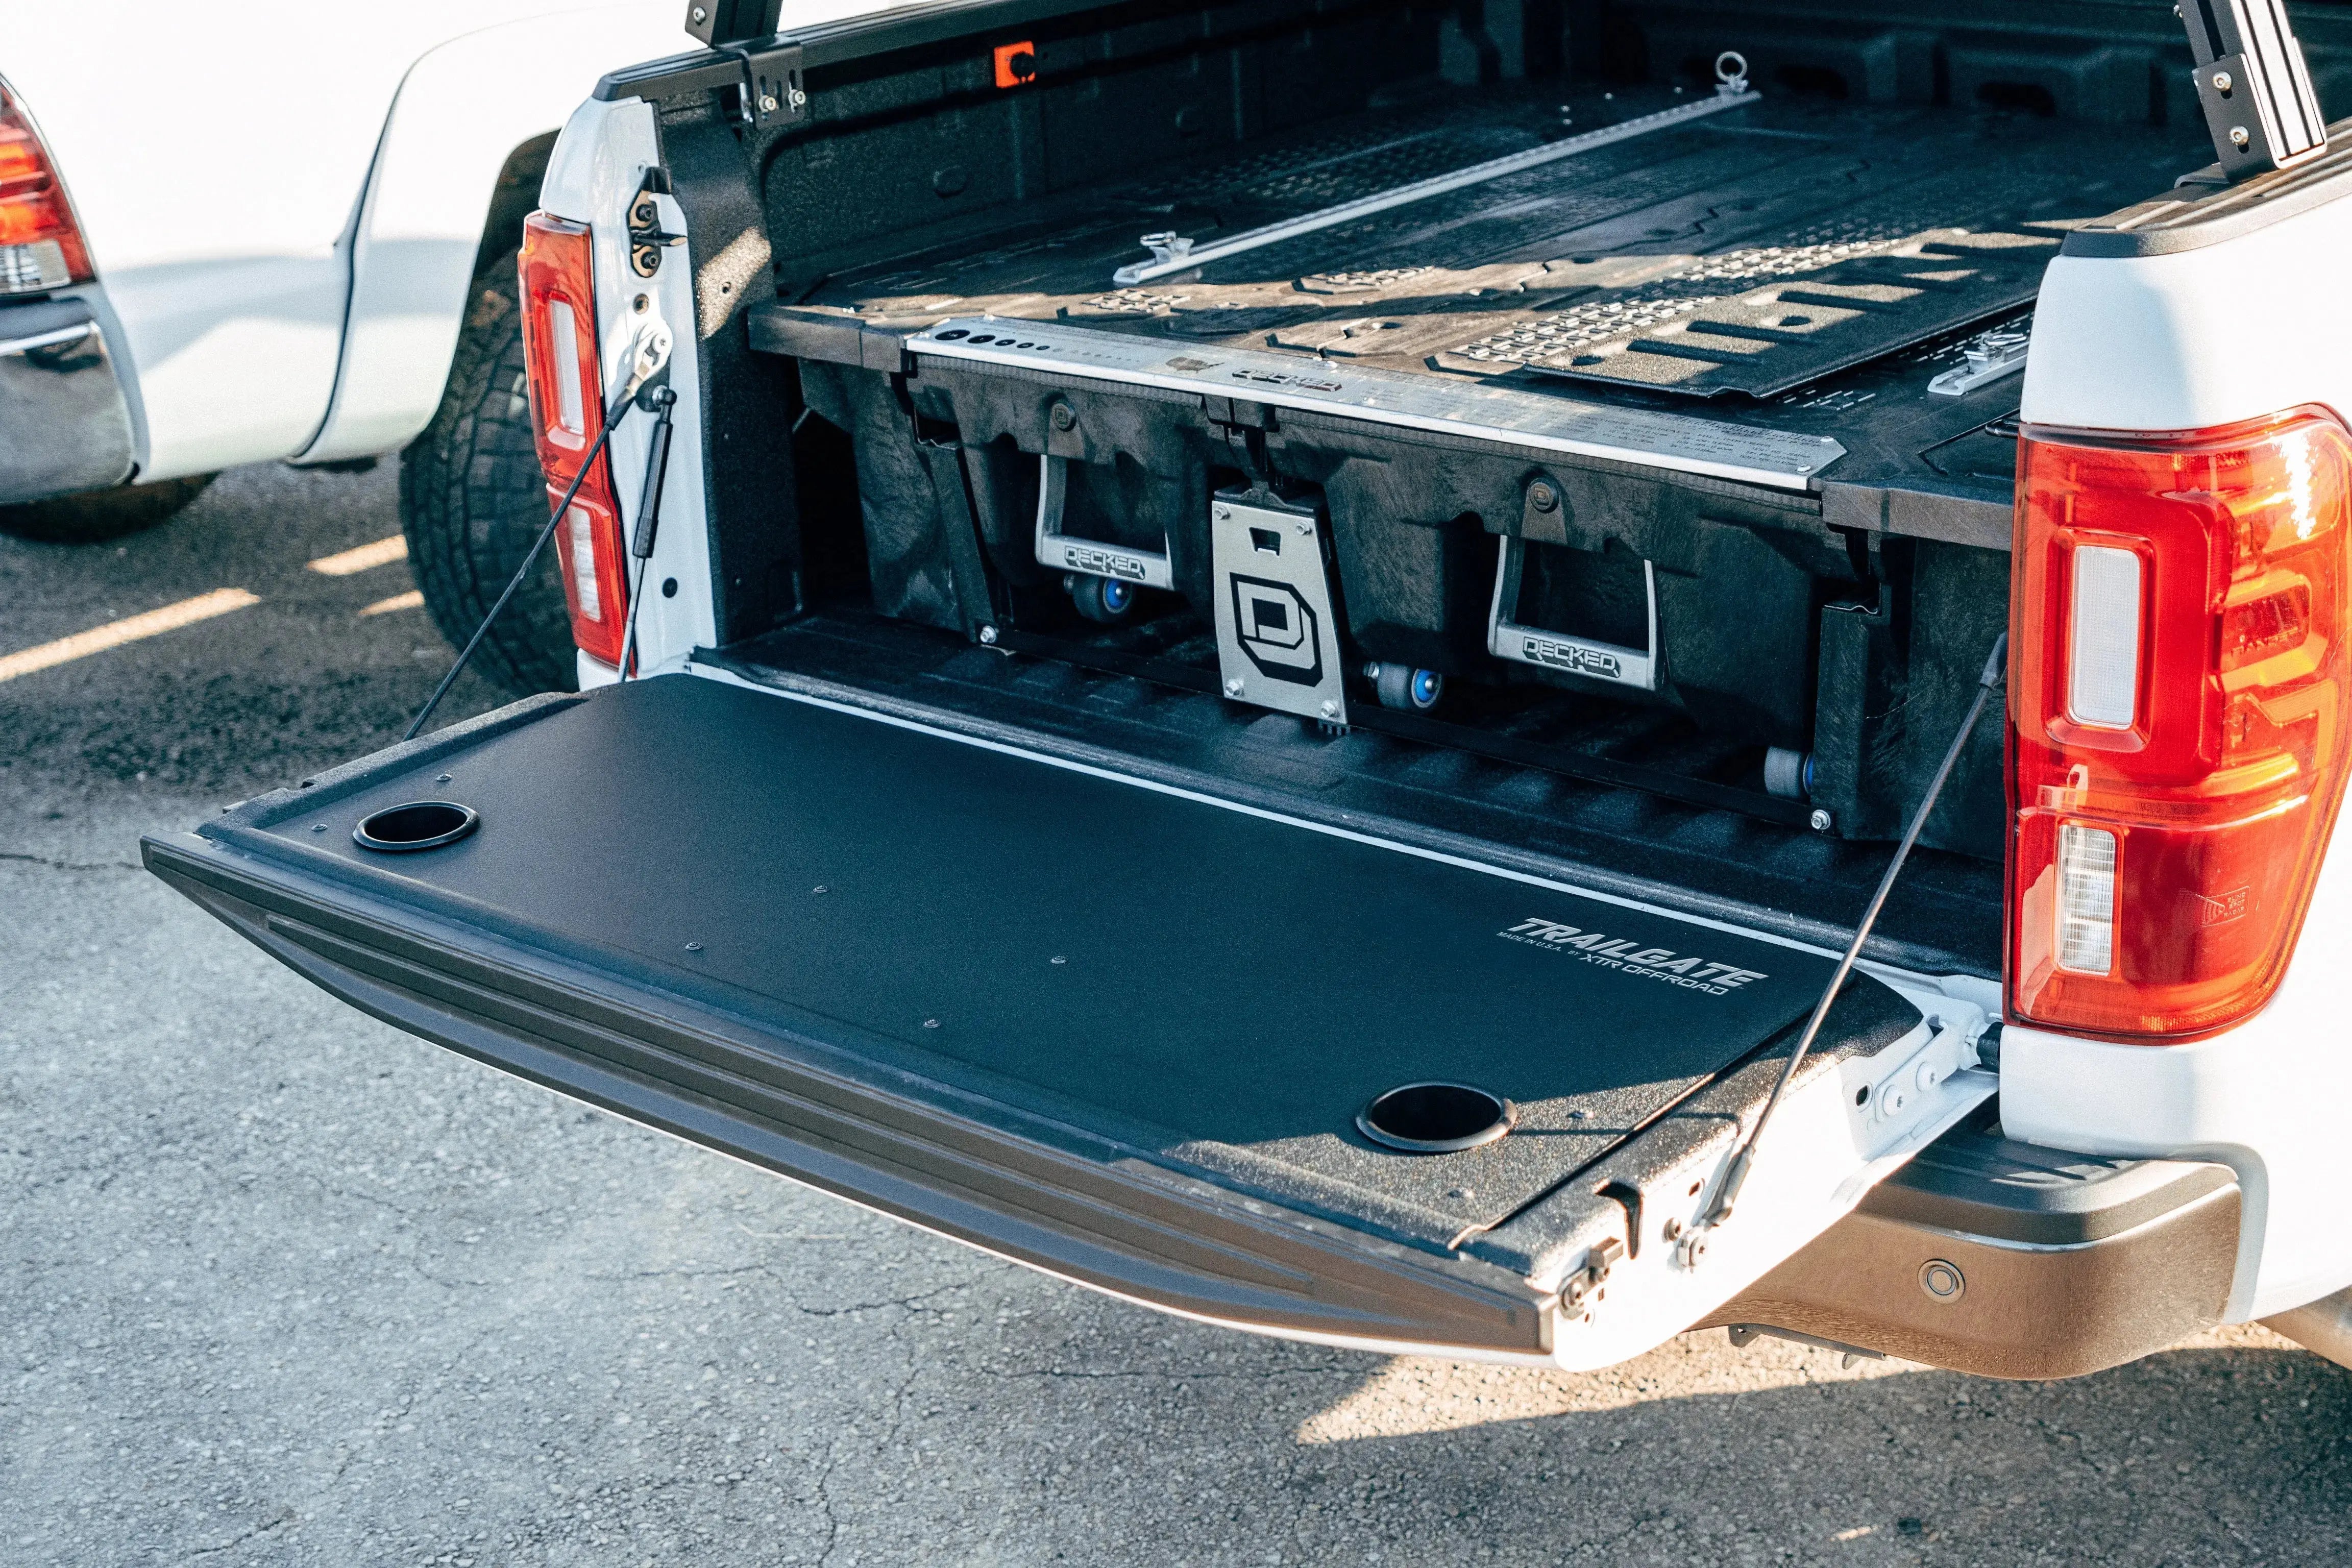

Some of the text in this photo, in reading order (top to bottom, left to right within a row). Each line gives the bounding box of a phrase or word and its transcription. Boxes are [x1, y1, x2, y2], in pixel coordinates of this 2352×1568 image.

[1065, 546, 1145, 580] DECKED
[1523, 636, 1621, 678] DECKED
[2223, 906, 2244, 917] RADAR
[1496, 932, 1526, 942] MADE
[1536, 941, 1561, 951] U.S.A.
[1578, 953, 1624, 969] XTR
[1621, 965, 1729, 995] OFFROAD
[1507, 918, 1769, 987] TRAILGATE
